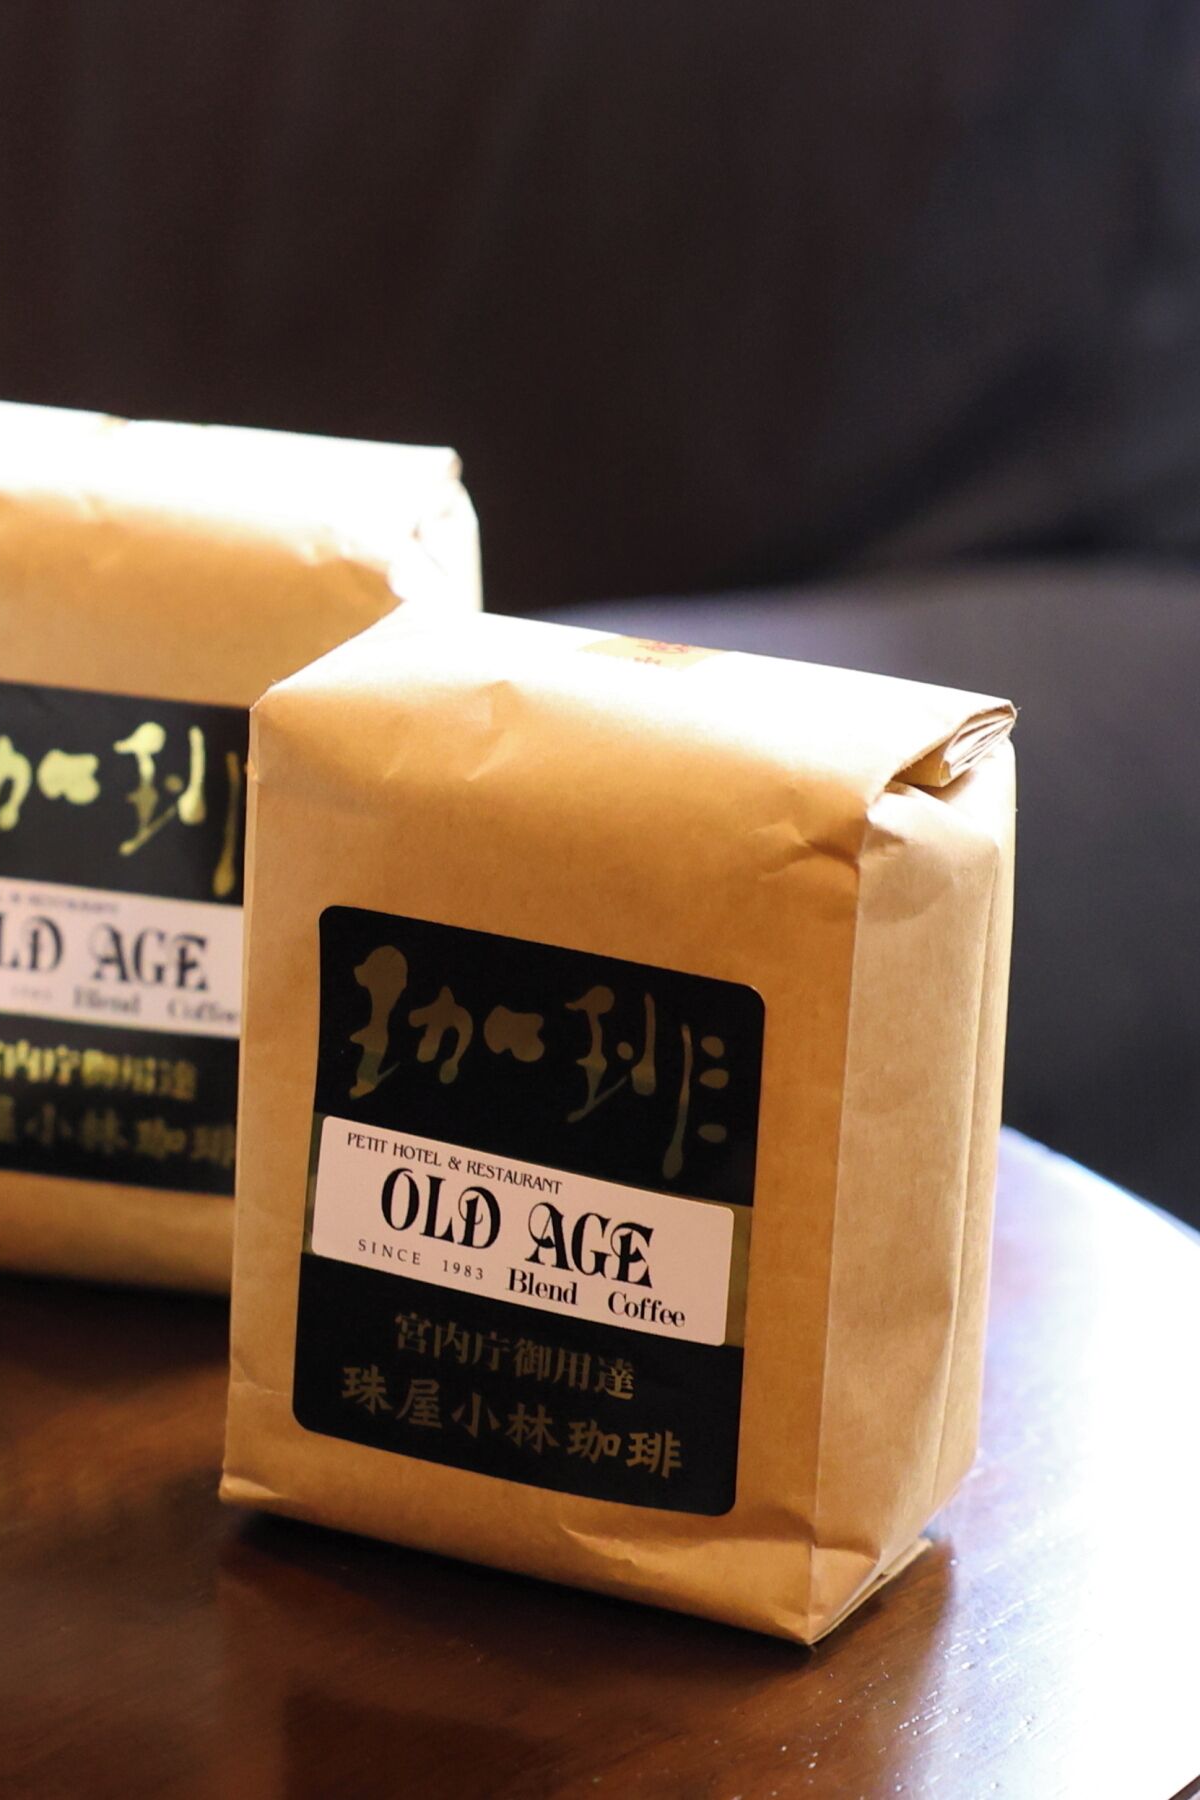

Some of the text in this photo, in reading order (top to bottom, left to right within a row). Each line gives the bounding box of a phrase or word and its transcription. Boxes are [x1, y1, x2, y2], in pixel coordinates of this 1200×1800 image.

[90, 923, 208, 991] AGE
[350, 945, 729, 1179] 珈琲
[347, 1132, 563, 1195] PETIT HOTEL & RESTAURANT
[358, 1238, 484, 1280] SINCE 1983
[381, 1167, 654, 1288] OLD AGE
[506, 1267, 686, 1328] Blend Coffee
[395, 1311, 635, 1400] 宮内庁御用達
[342, 1363, 683, 1480] 珠屋小林珈琲
